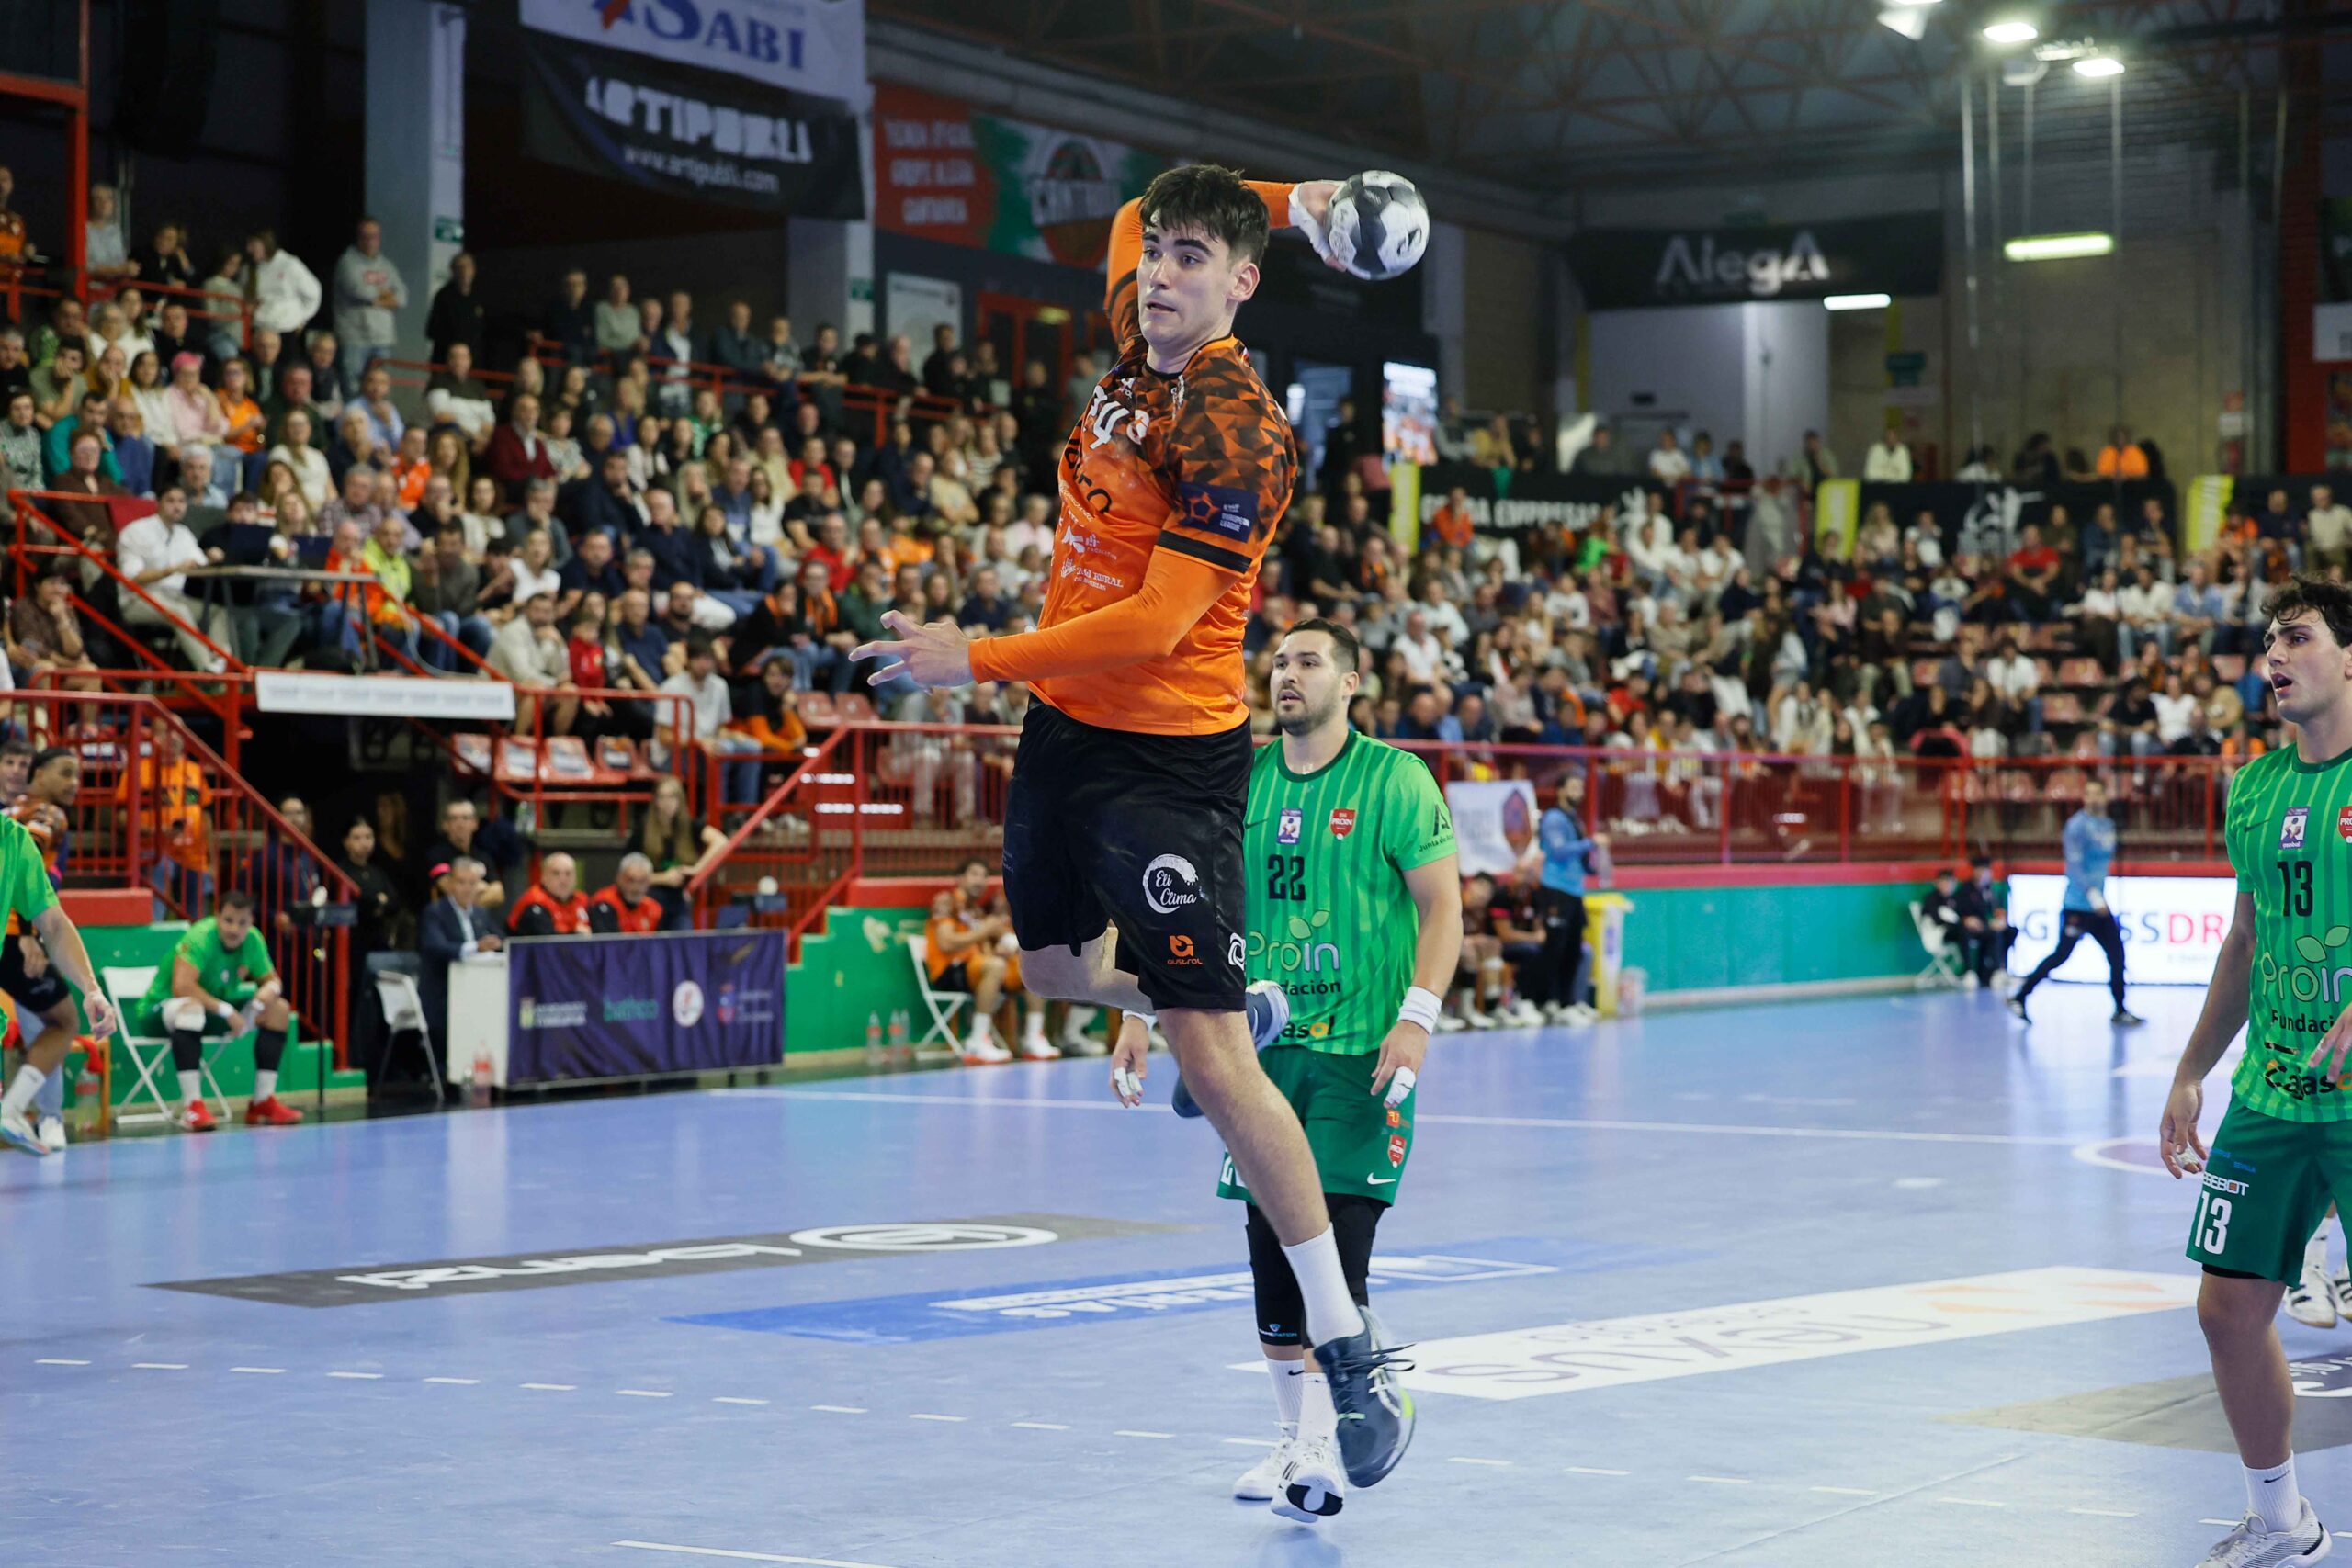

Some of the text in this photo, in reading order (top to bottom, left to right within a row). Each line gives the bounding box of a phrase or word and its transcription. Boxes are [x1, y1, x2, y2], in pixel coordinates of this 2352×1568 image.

[2340, 818, 2352, 826] PRO
[1156, 870, 1172, 887] Eli
[1160, 888, 1197, 906] Clima
[1268, 855, 1306, 901] 22
[2277, 860, 2313, 917] 13
[2194, 1190, 2232, 1255] 13
[1426, 1314, 1951, 1383] nexus
